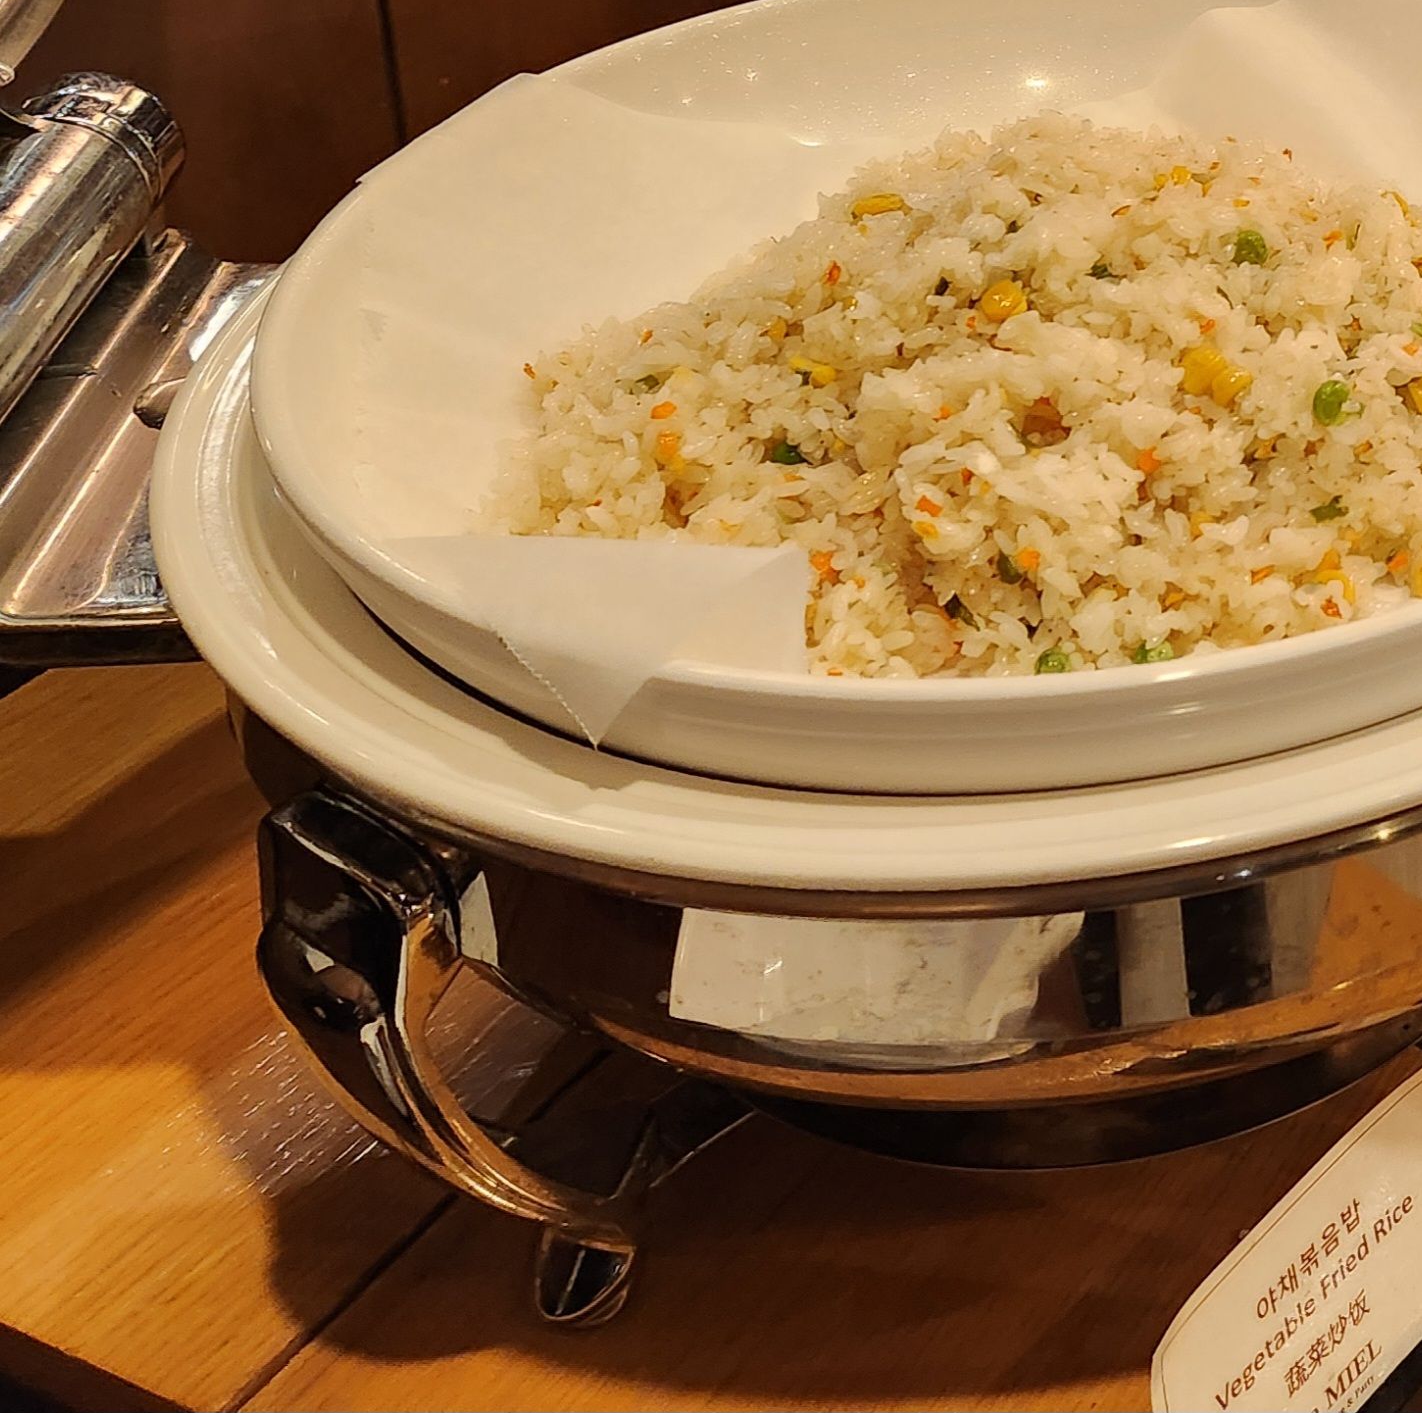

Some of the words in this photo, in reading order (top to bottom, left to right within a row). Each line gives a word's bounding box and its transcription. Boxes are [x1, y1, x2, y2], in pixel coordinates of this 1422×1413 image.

[1214, 1298, 1317, 1411] Vegetable
[1321, 1233, 1370, 1301] Fried
[1374, 1194, 1414, 1245] Rice
[1256, 1197, 1361, 1320] 야채볶음밥
[1283, 1288, 1371, 1399] 蔬菜炒饭
[1324, 1339, 1382, 1410] MIEL
